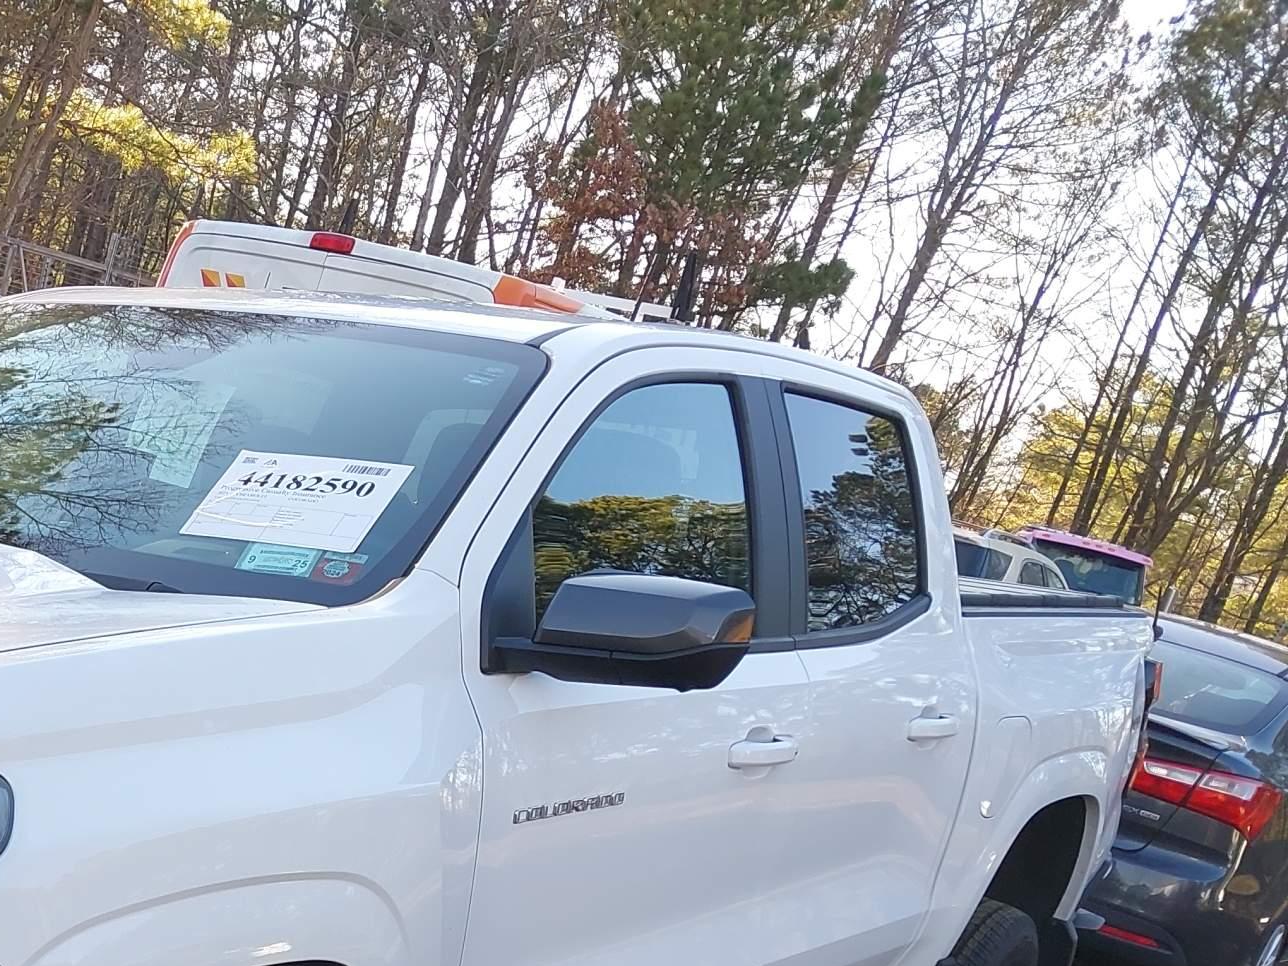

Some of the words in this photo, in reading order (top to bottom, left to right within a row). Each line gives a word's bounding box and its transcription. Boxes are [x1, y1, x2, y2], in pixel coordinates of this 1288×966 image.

[238, 471, 375, 498] 44182590
[248, 555, 257, 564] 9
[292, 559, 310, 569] 25
[512, 792, 624, 824] COLORADO
